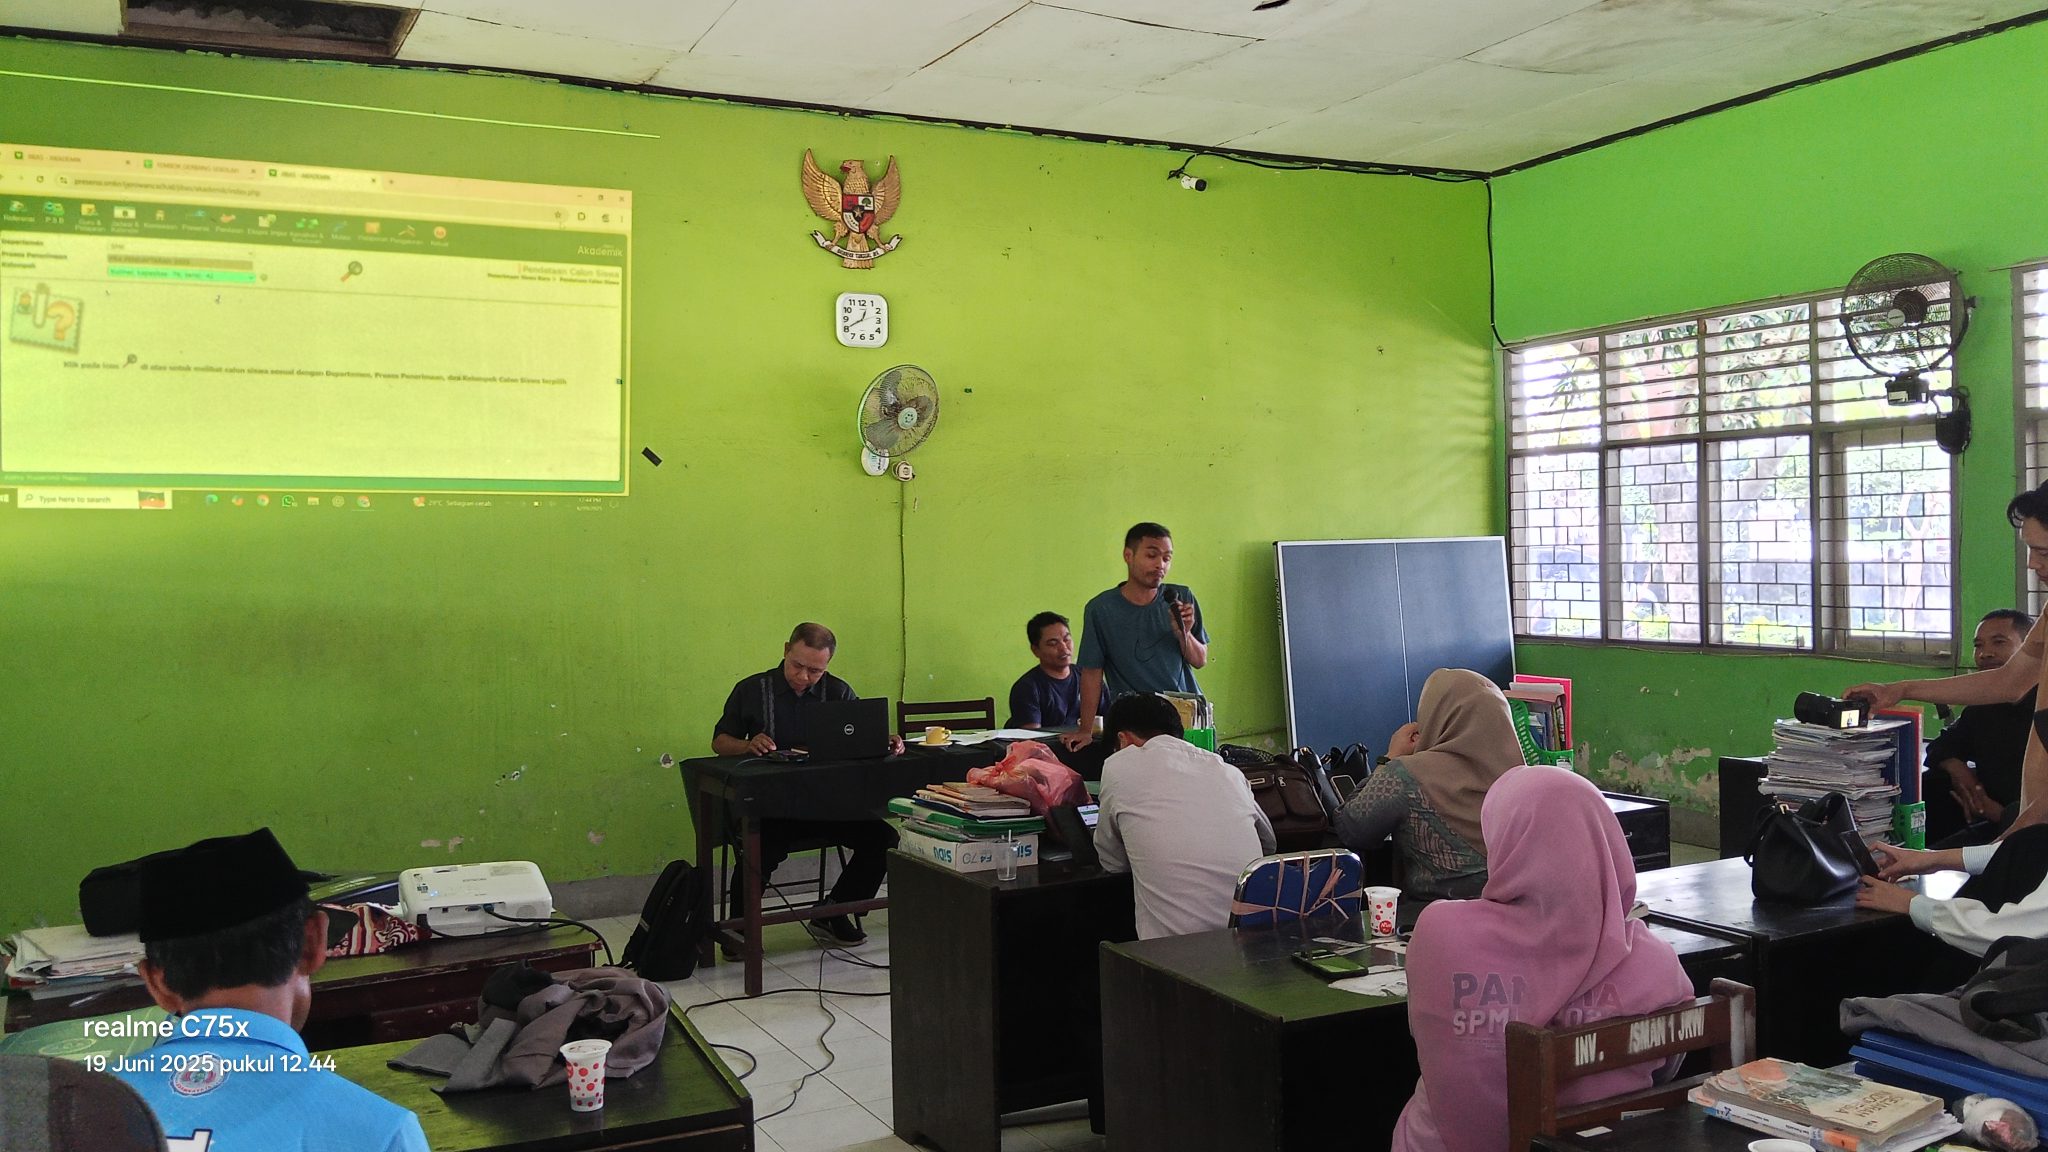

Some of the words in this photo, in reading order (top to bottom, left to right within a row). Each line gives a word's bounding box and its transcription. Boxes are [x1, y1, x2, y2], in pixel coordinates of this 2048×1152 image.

[577, 245, 623, 257] Akademik
[843, 306, 852, 314] 10
[843, 315, 849, 323] 9
[875, 317, 881, 325] 3
[843, 325, 850, 333] 8
[860, 333, 866, 341] 6
[39, 495, 56, 504] Type
[58, 495, 75, 503] here
[87, 496, 111, 504] search
[1678, 1006, 1706, 1041] JRW
